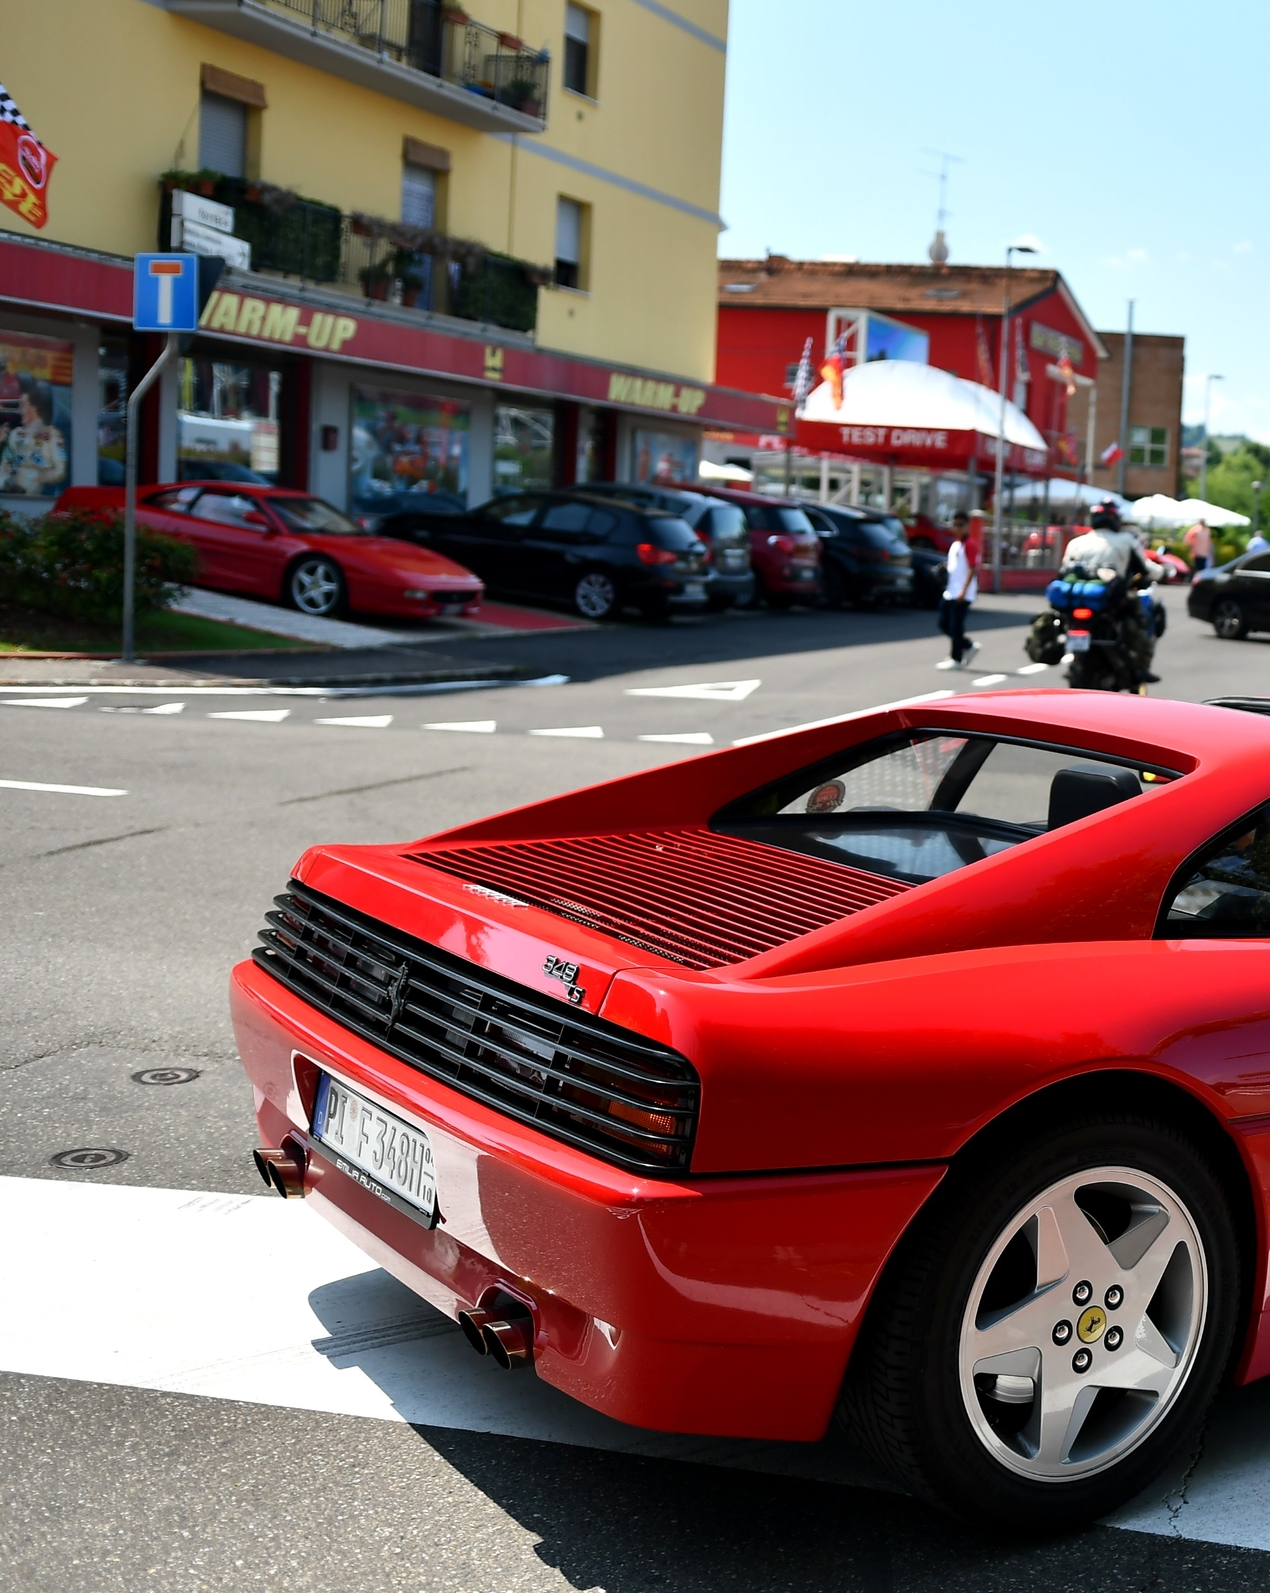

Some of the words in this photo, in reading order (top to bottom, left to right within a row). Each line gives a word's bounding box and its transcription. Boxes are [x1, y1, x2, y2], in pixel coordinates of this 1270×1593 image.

[199, 290, 358, 352] ARM-UP
[607, 372, 707, 416] WARM-UP
[839, 426, 887, 446] TEST
[890, 428, 949, 449] DRIVE
[542, 954, 579, 982] 348
